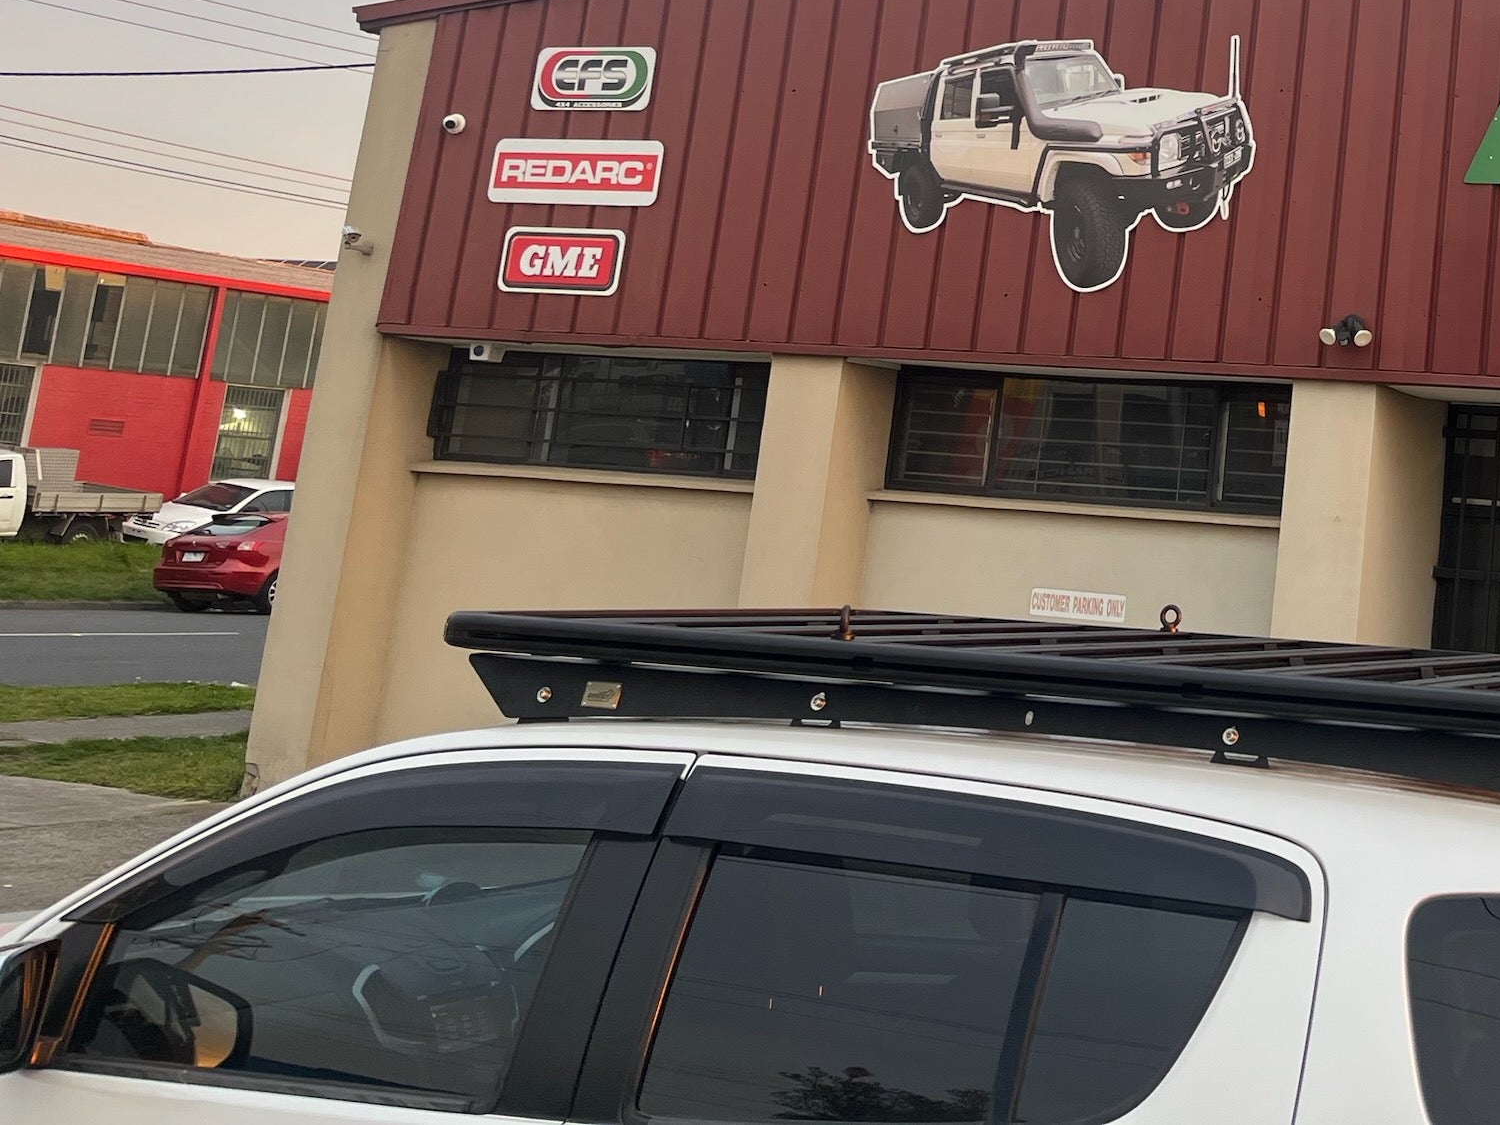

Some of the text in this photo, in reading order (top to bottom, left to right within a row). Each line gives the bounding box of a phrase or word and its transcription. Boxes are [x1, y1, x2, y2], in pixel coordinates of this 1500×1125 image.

[555, 59, 629, 91] EFS
[501, 158, 644, 185] REDARC
[519, 244, 603, 279] GME
[1031, 592, 1126, 617] CUSTOMER PARKING ONLY
